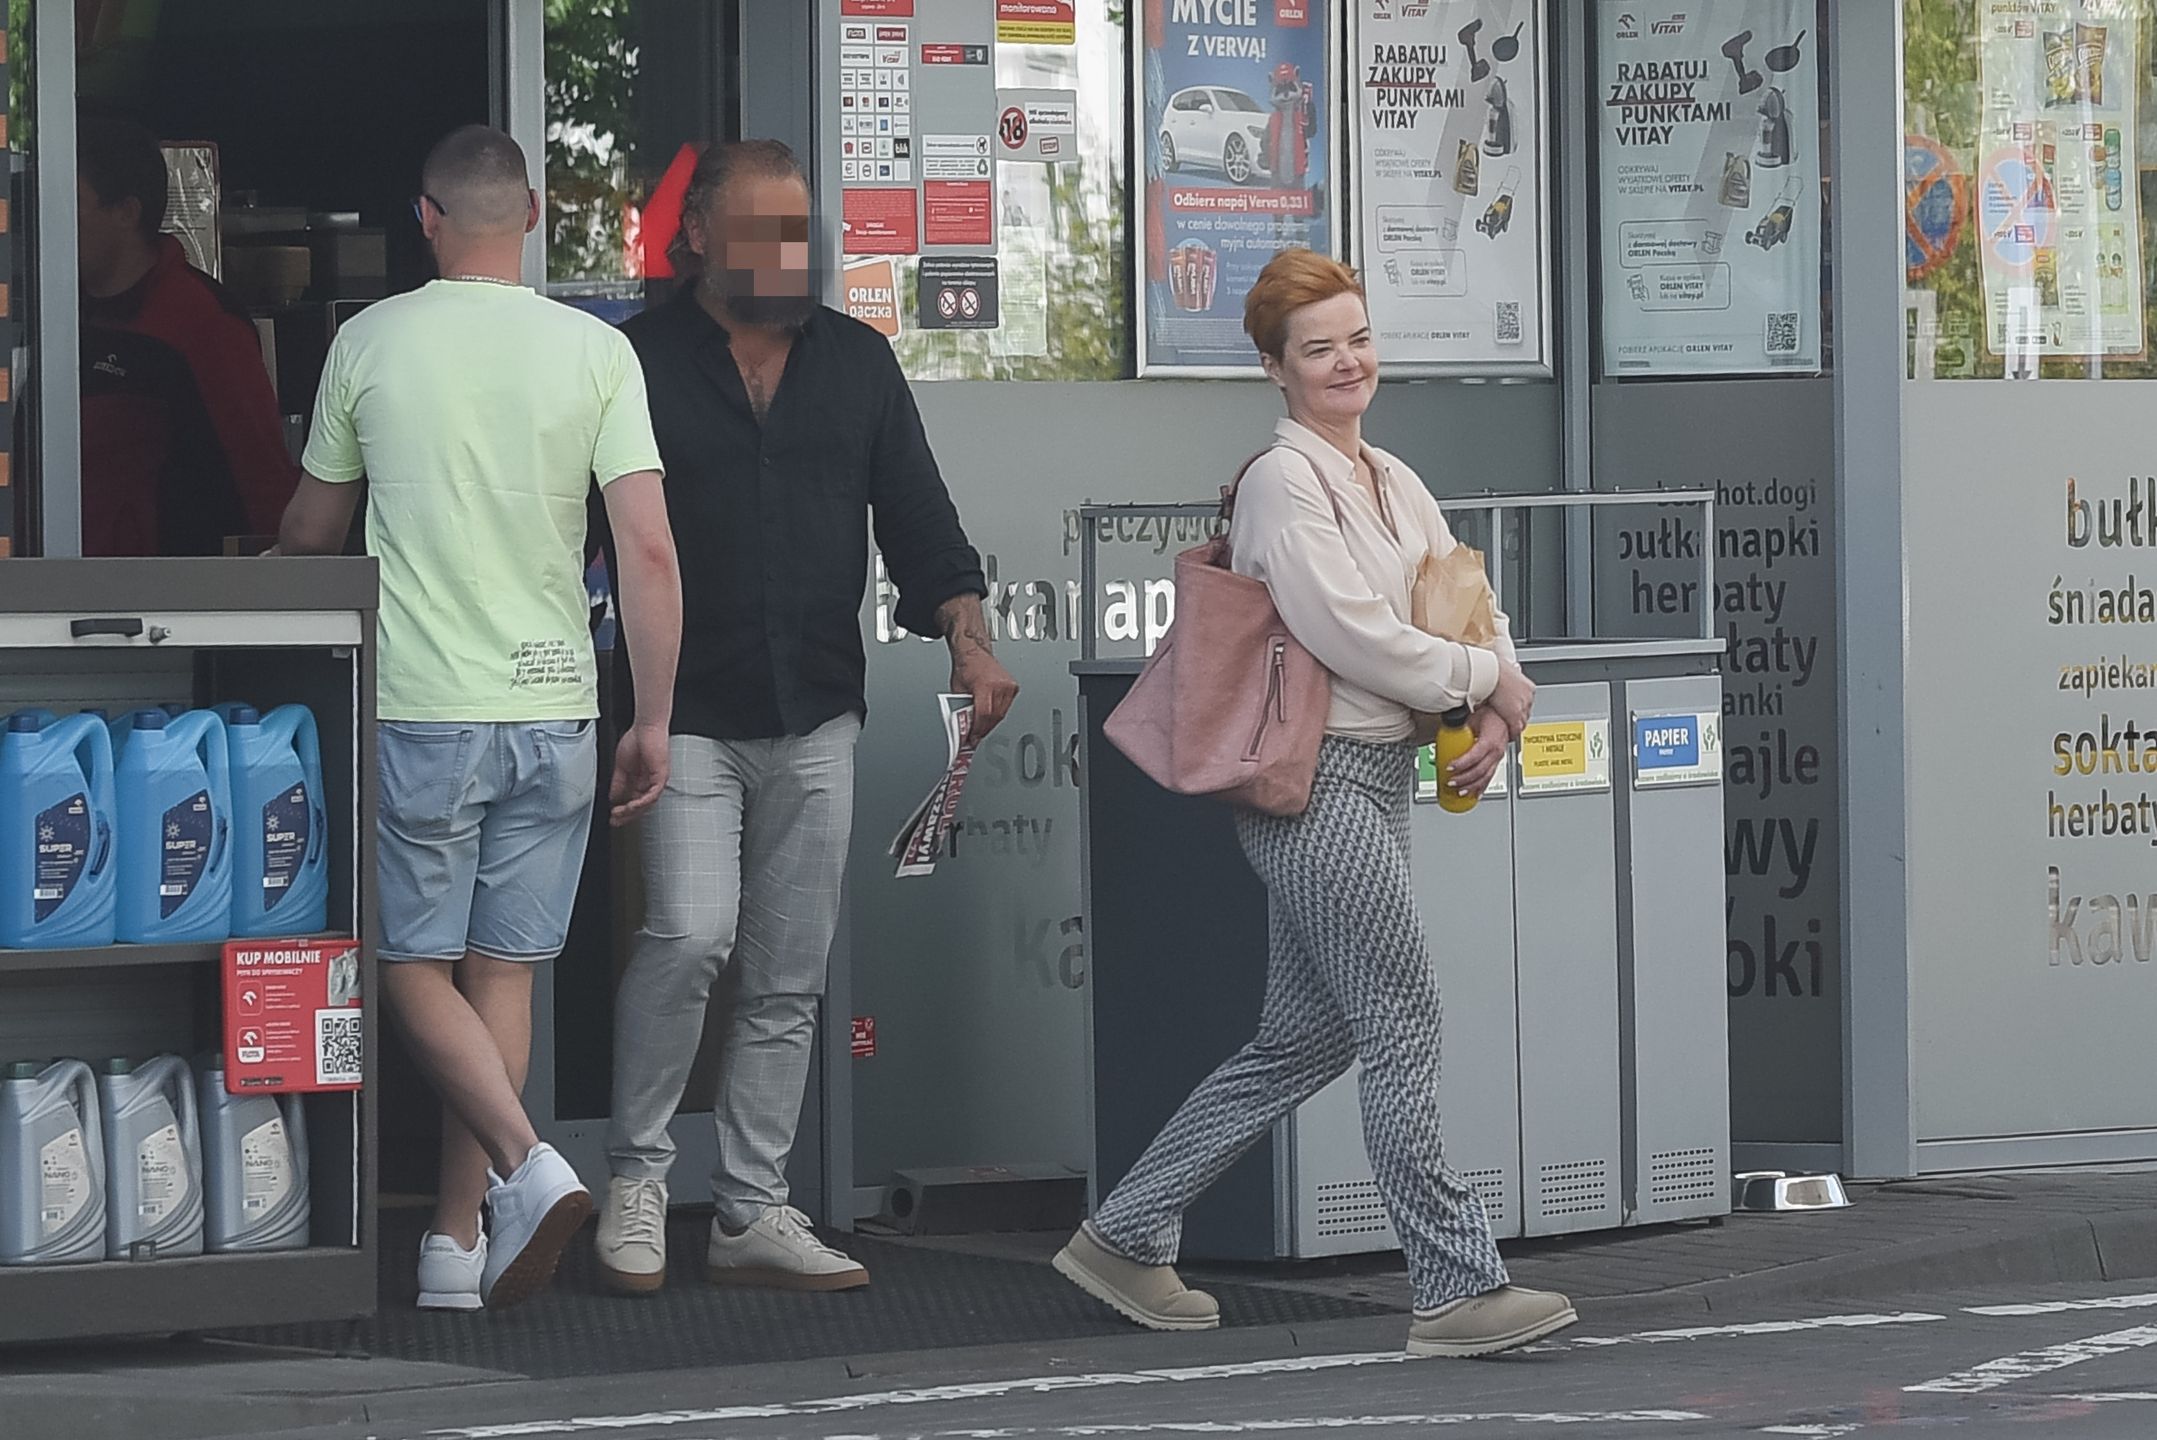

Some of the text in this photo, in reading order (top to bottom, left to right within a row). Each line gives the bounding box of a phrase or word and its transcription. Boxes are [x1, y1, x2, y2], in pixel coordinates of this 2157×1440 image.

[1172, 0, 1257, 26] MYCIE
[1616, 31, 1639, 39] ORLEN
[1187, 34, 1267, 63] Z VERVĄ!
[1374, 44, 1446, 64] RABATUJ
[1368, 66, 1436, 84] ZAKUPY
[1618, 60, 1707, 81] RABATUJ
[1377, 88, 1465, 108] PUNKTAMI
[1610, 82, 1695, 101] ZAKUPY
[1372, 110, 1418, 129] VITAY
[1621, 102, 1731, 124] PUNKTAMI
[1616, 125, 1674, 145] VITAY
[1668, 184, 1705, 192] VITAY.PL
[1174, 193, 1215, 207] Odbierz
[1217, 194, 1248, 211] napój
[1249, 195, 1278, 208] Verva
[1176, 220, 1185, 229] w
[1187, 217, 1212, 230] cenie
[1214, 217, 1265, 235] dowolnego
[1220, 237, 1245, 253] myjni
[848, 287, 891, 303] ORLEN
[1660, 282, 1683, 290] ORLEN
[1686, 345, 1710, 353] ORLEN
[1716, 477, 1815, 511] hot.dogi
[1063, 508, 1230, 555] peczywo
[1619, 516, 1820, 568] ułknapki
[1632, 568, 1786, 624] heraty
[1717, 621, 1817, 687] łaty
[1645, 727, 1689, 748] PAPIER
[1729, 728, 1819, 800] ajle
[165, 840, 197, 850] SUPER
[266, 831, 295, 843] SUPER
[39, 843, 72, 853] SUPER
[236, 950, 321, 966] KUP MOBILNIE
